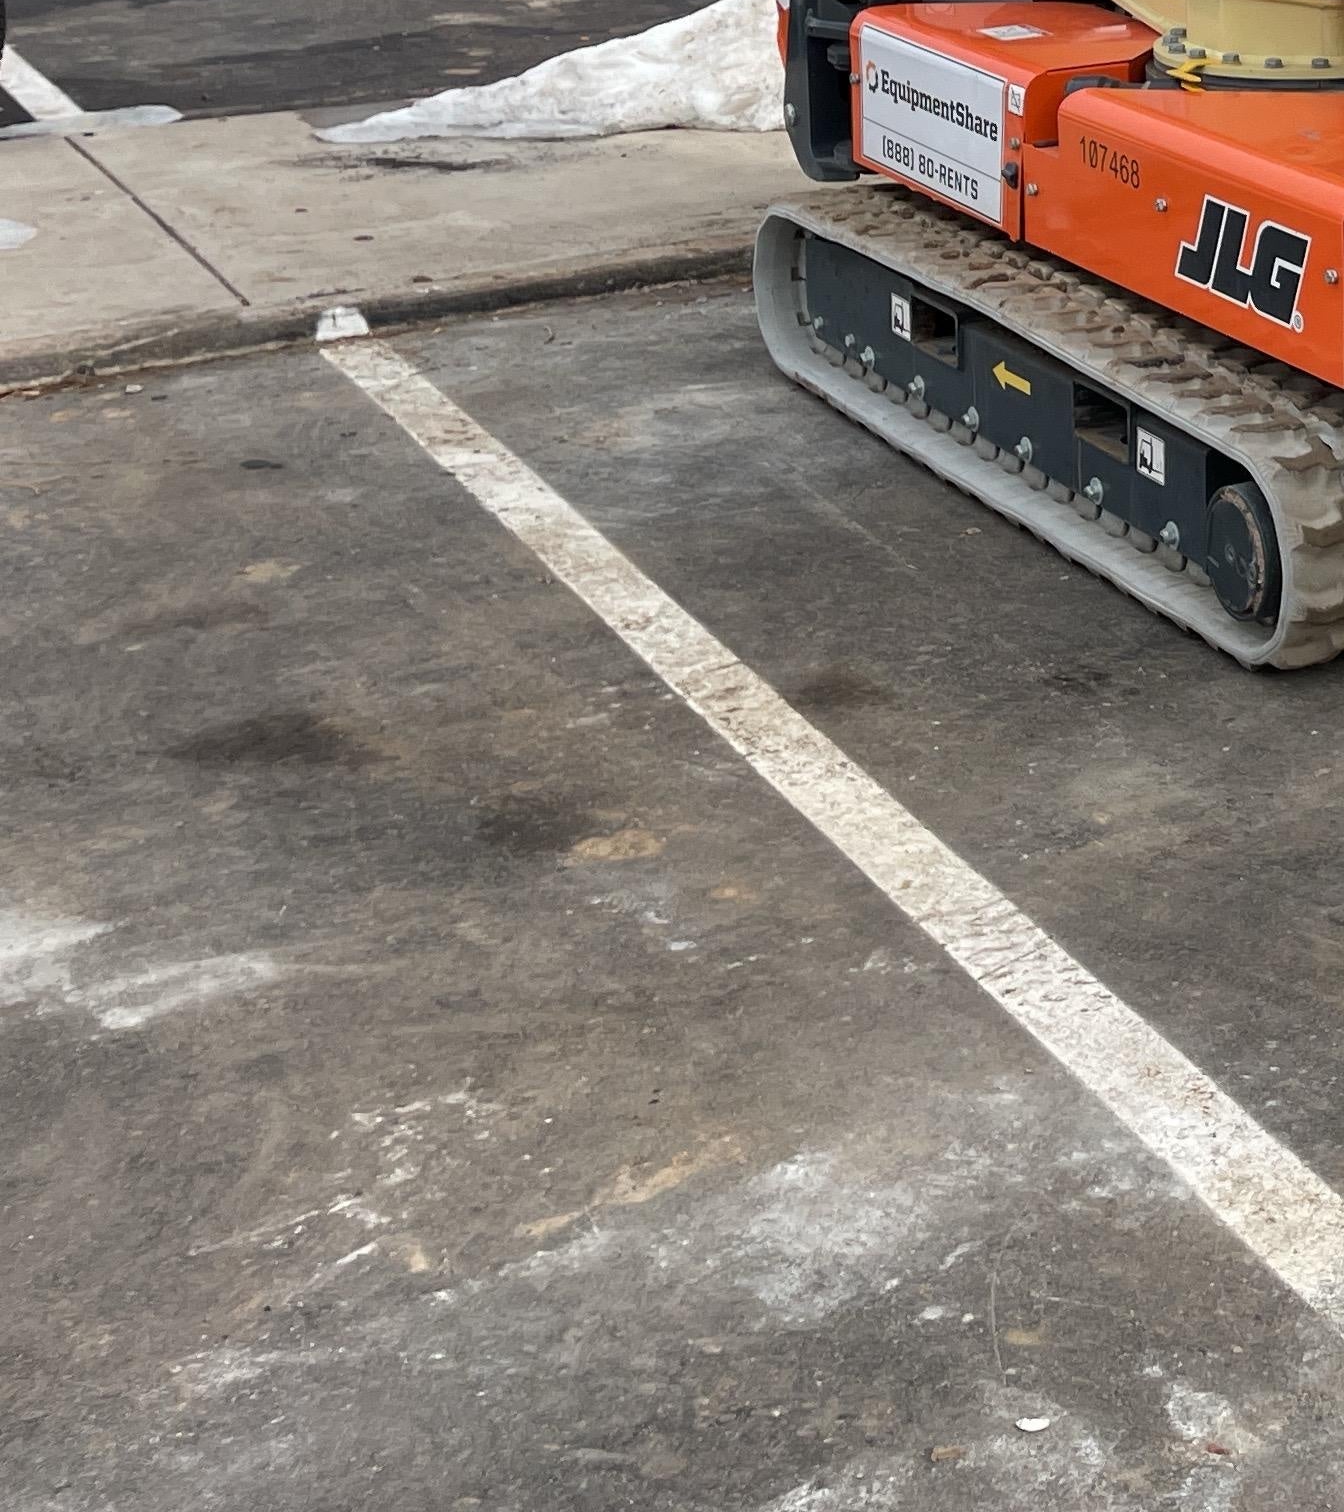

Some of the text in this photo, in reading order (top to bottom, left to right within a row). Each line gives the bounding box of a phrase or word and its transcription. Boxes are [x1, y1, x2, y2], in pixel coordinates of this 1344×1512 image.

[881, 69, 999, 142] EquipmentShare
[882, 135, 979, 201] (888) 80-RENTS
[1079, 136, 1141, 189] 107468
[1174, 194, 1313, 331] JLG
